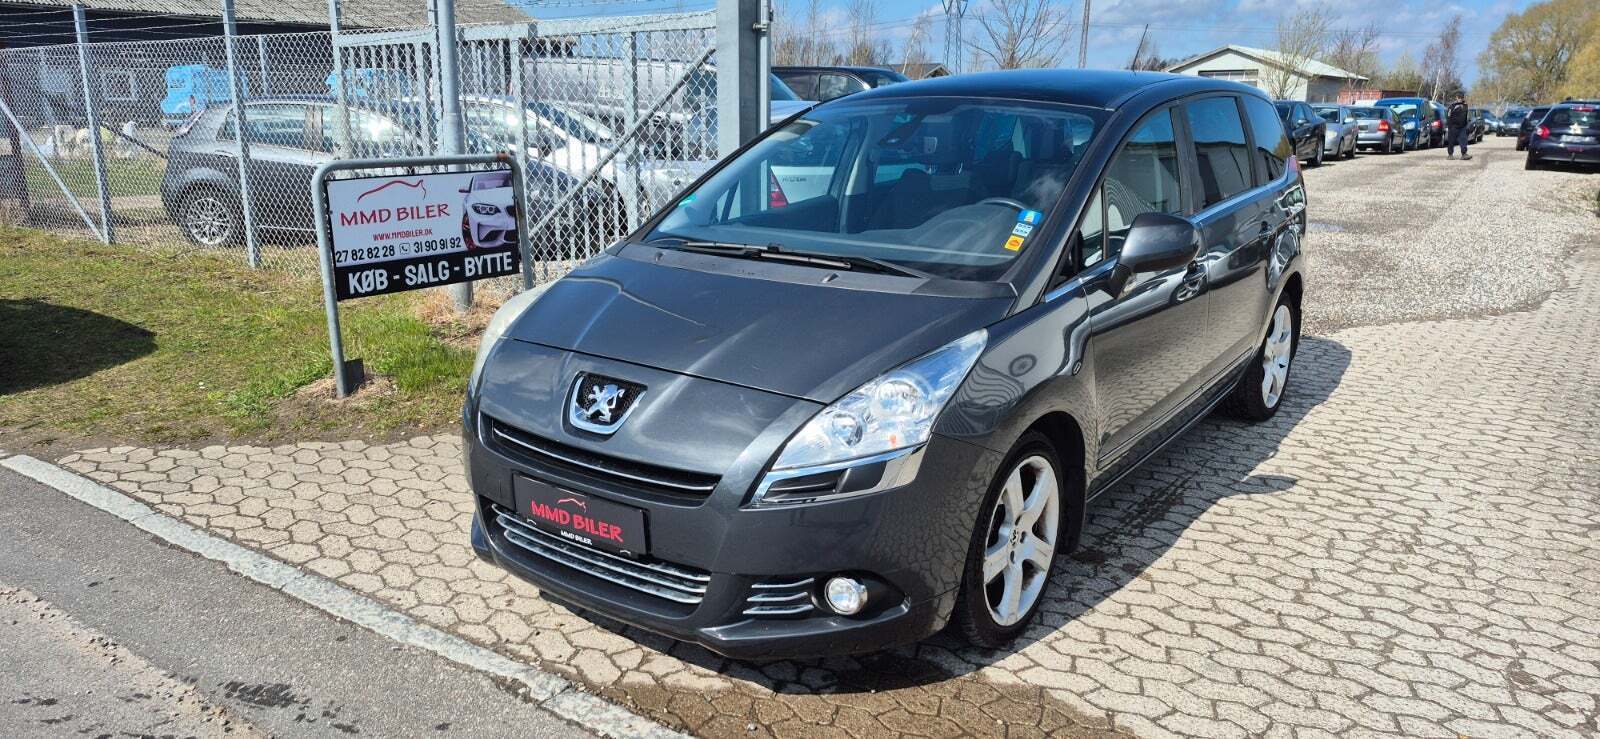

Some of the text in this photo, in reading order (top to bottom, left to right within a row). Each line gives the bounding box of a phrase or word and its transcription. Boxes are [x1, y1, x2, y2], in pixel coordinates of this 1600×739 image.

[341, 203, 450, 226] MMD BILER
[373, 228, 433, 241] WWW.MMDBILER.DK
[335, 236, 461, 263] 27 82 82 28 31 90 91 92
[348, 268, 389, 294] KØB
[404, 260, 450, 286] SALG
[464, 251, 512, 277] BYTTE
[530, 500, 624, 542] MMD BILER
[560, 530, 593, 545] MMD BILER
